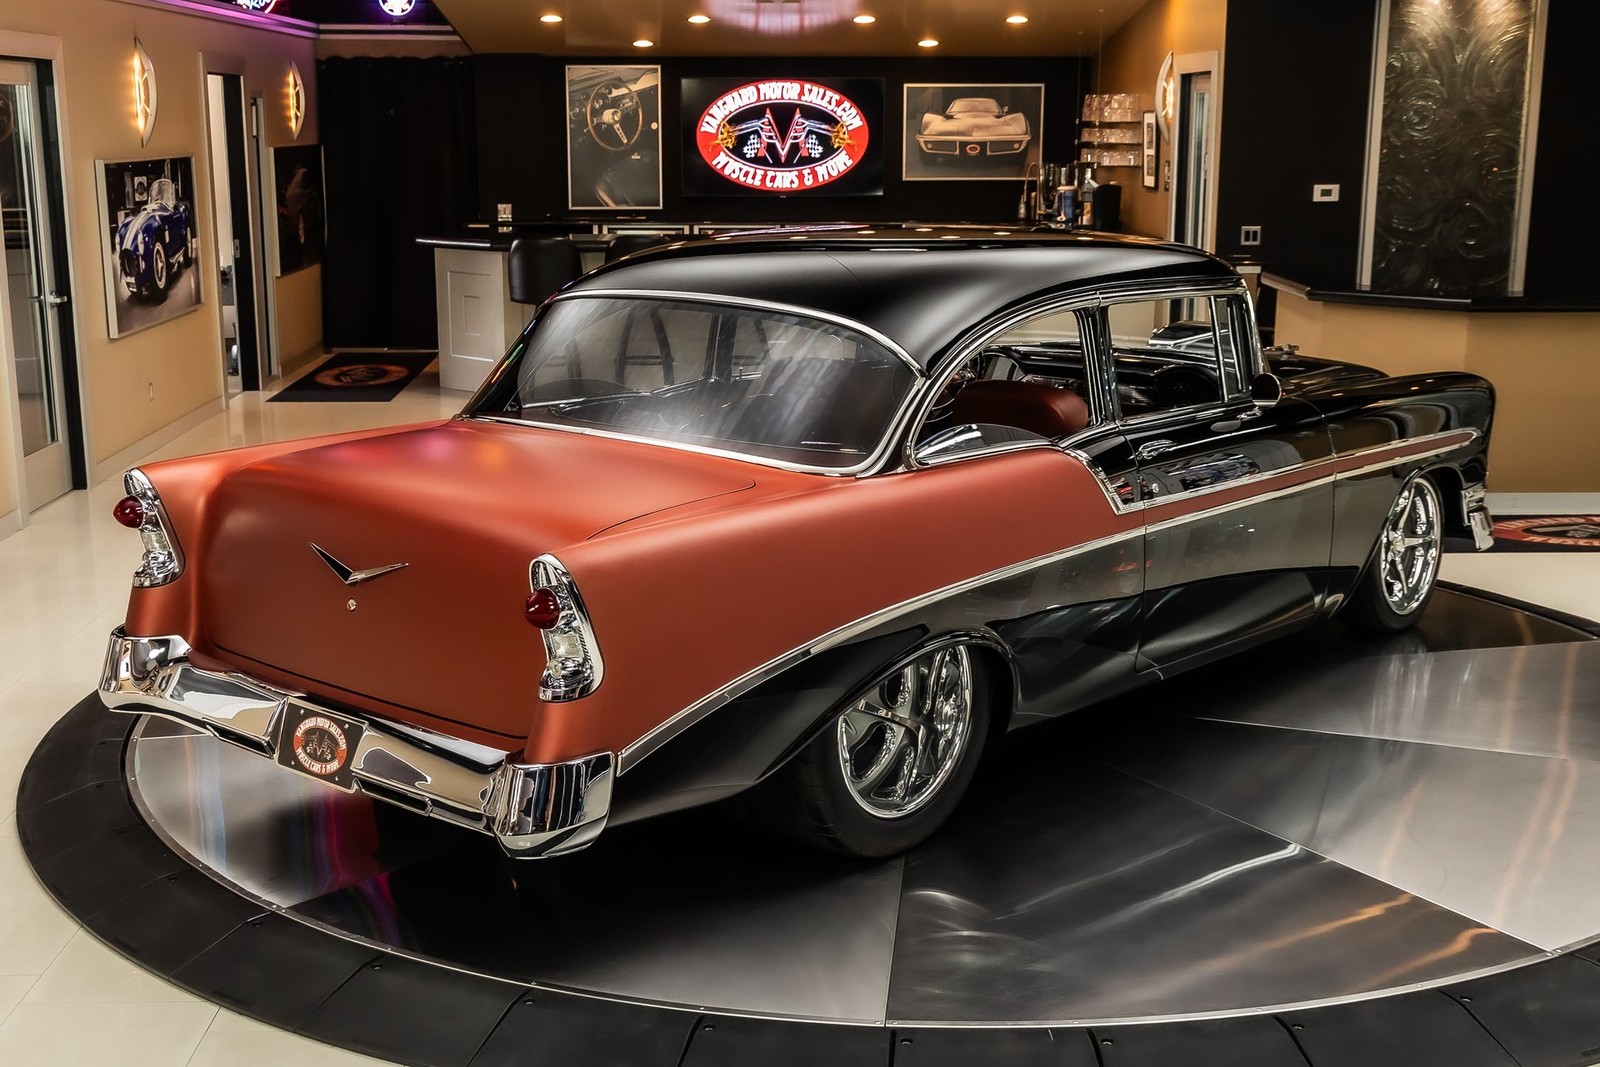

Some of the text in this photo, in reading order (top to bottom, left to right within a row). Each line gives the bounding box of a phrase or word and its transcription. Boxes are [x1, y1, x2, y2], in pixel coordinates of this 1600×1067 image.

[700, 81, 863, 134] VANGUARD MOTOR SALES.COM
[711, 150, 854, 188] MUSCLE CARS & MORE
